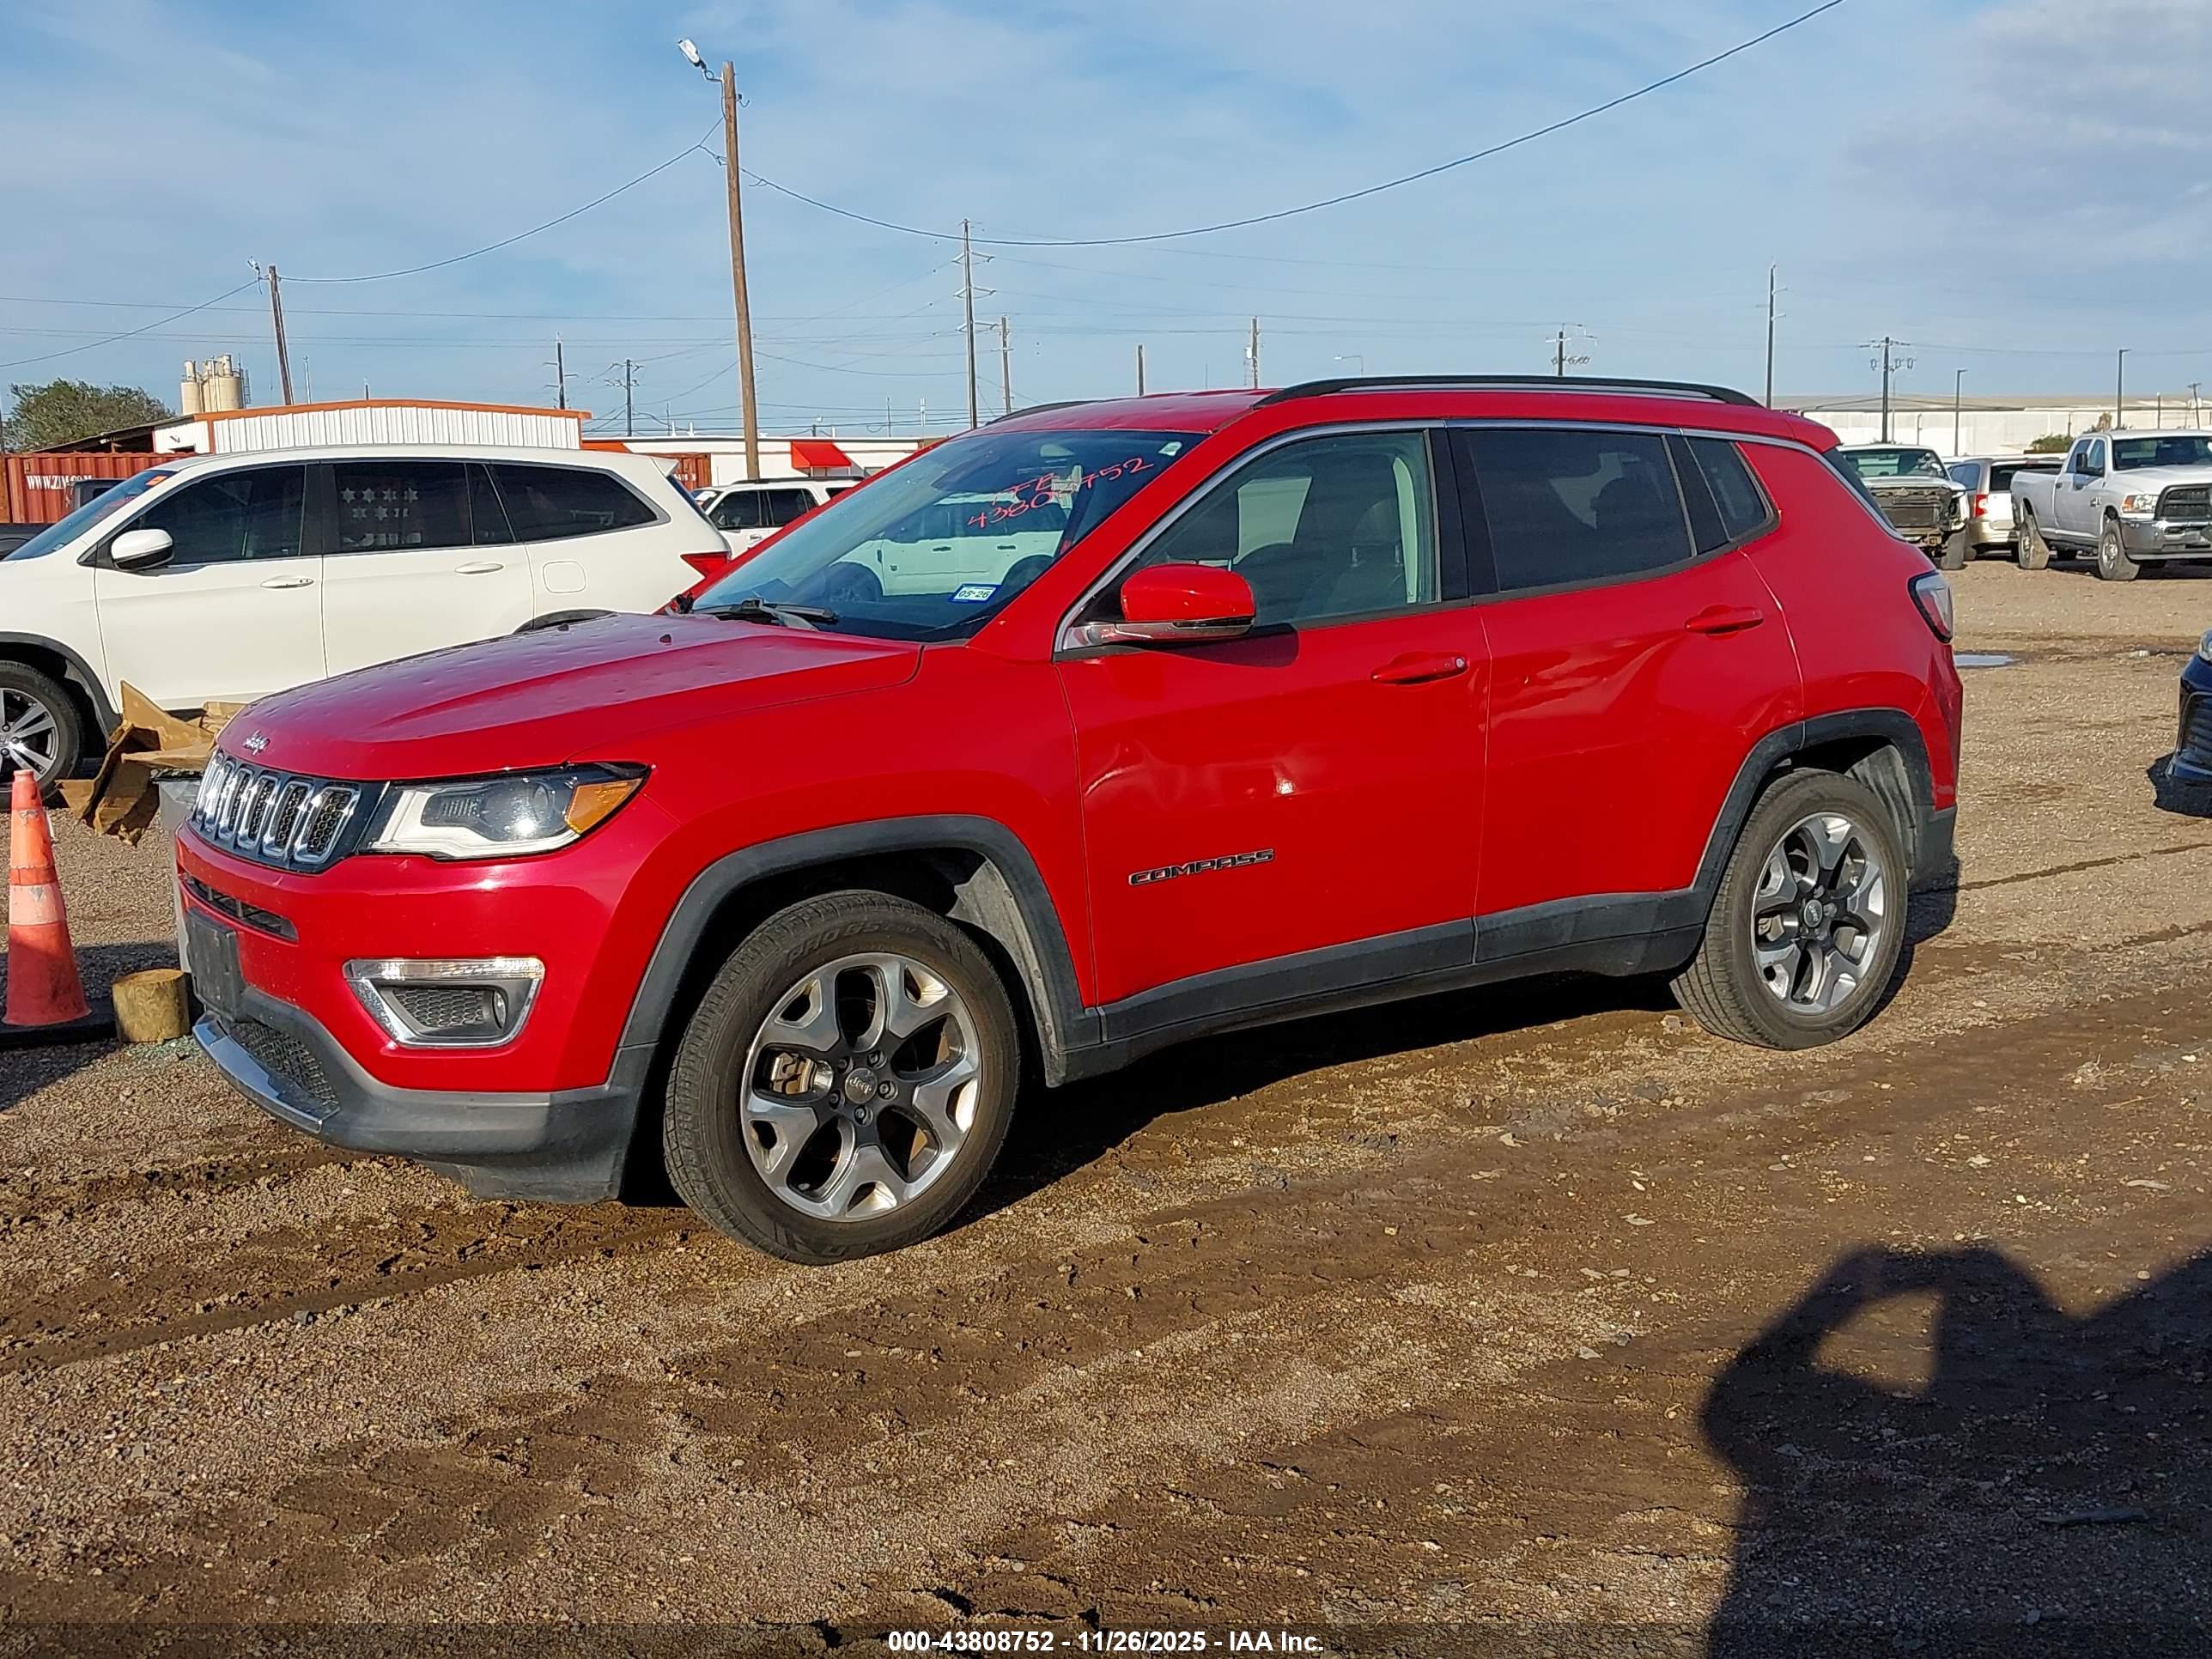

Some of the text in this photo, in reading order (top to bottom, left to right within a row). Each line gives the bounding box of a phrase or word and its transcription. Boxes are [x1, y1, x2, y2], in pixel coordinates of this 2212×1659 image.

[26, 475, 92, 490] WWW.ZIM
[968, 458, 1154, 528] 4380752
[1128, 848, 1274, 886] COMPASS
[849, 1076, 872, 1095] Jeep
